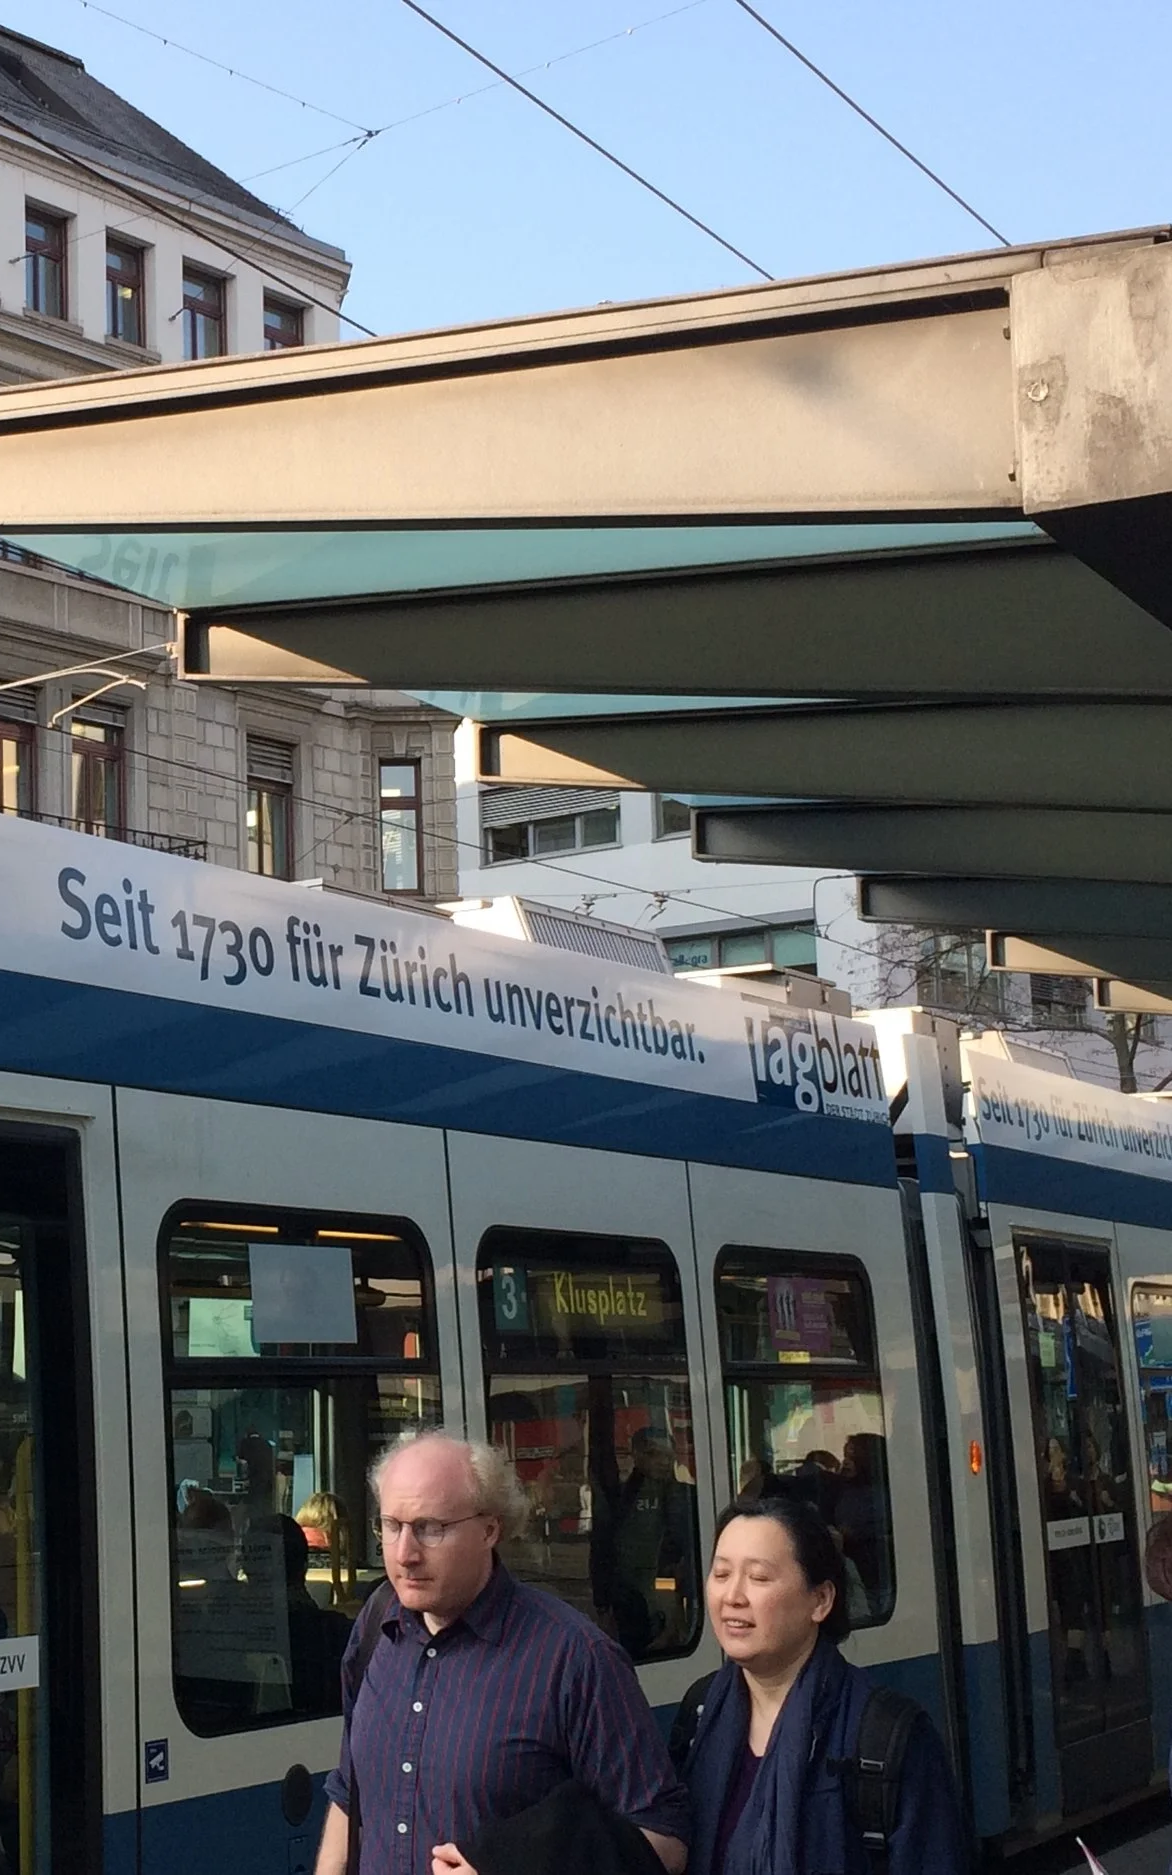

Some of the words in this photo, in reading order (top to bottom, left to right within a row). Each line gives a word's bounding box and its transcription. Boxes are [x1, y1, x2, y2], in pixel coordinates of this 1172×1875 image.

[58, 866, 160, 955] Seit
[170, 909, 274, 987] 1730
[286, 915, 344, 991] für
[354, 934, 475, 1018] Zürich
[484, 985, 706, 1065] unverzichtbar.
[742, 1005, 884, 1112] Tagblatt
[978, 1076, 1013, 1125] Seit
[1014, 1098, 1050, 1141] 1730
[1050, 1094, 1074, 1139] für
[1073, 1100, 1119, 1148] Zürich
[501, 1276, 518, 1319] 3
[553, 1271, 648, 1326] Klusplatz
[0, 1654, 26, 1675] ZVV
